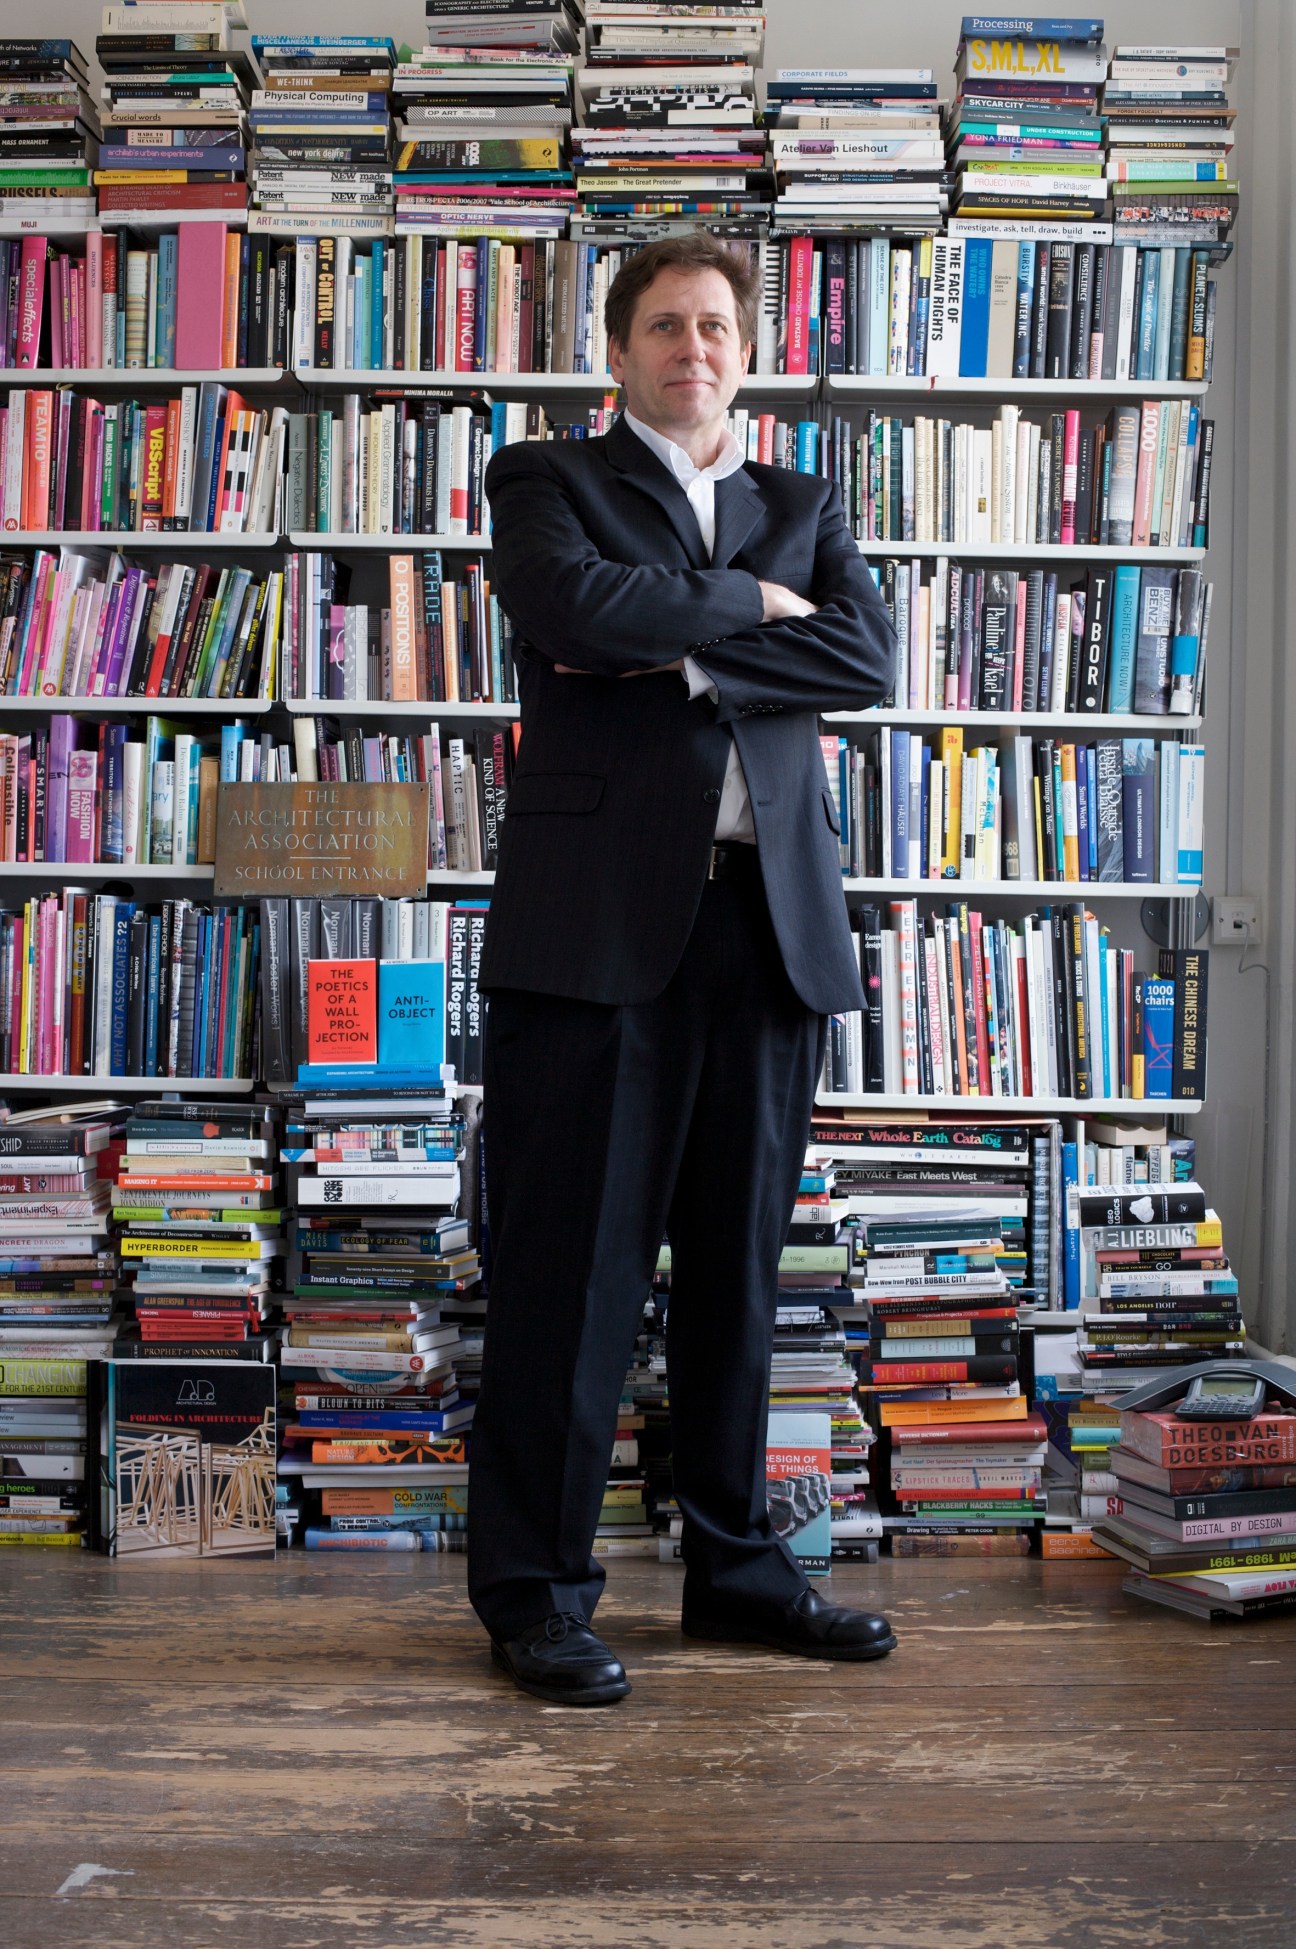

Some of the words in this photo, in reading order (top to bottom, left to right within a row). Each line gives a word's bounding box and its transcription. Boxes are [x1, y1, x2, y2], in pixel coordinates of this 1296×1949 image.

[972, 19, 1033, 32] Processing
[971, 40, 1065, 73] S,M,L,XL
[276, 77, 314, 86] WE-THINK
[264, 91, 306, 101] Physical
[309, 92, 364, 104] Computing
[969, 98, 1002, 109] SKYCAR
[1004, 100, 1024, 109] CITY
[110, 113, 137, 122] Crucial
[139, 113, 162, 121] words
[1048, 128, 1094, 137] CONSTRUCTION
[969, 134, 995, 143] YONA
[997, 135, 1044, 145] FRIEDMAN
[781, 144, 817, 153] Atelier
[819, 144, 839, 153] Van
[842, 144, 888, 153] Lieshout
[653, 178, 682, 186] Pretender
[974, 177, 1010, 187] PROJECT
[1010, 179, 1033, 188] VITRA.
[1053, 181, 1092, 191] Birkhäuser
[20, 221, 38, 229] MUJI
[256, 215, 272, 226] ART
[293, 219, 309, 227] TURN
[310, 219, 318, 227] OF
[319, 219, 330, 227] THE
[331, 218, 383, 228] MILLENNIUM
[955, 223, 1001, 234] investigate,
[1003, 225, 1019, 234] ask,
[1020, 225, 1036, 234] tell,
[1038, 226, 1060, 235] draw,
[1062, 227, 1083, 235] build
[318, 239, 334, 260] OUT
[950, 245, 961, 269] THE
[933, 245, 947, 292] HUMAN
[948, 272, 960, 304] FACE
[22, 258, 37, 343] specialeffects
[317, 273, 334, 324] CONTROL
[461, 290, 475, 322] ART
[826, 278, 845, 345] Empire
[932, 295, 945, 341] RIGHTS
[947, 307, 959, 324] OF
[460, 325, 474, 362] NOW
[34, 395, 48, 460] TEAM10
[105, 423, 114, 442] MIND
[1116, 416, 1135, 479] COLLAPSE
[104, 444, 113, 467] HACKS
[146, 427, 164, 500] VBScript
[985, 607, 1006, 652] Pauline
[1087, 579, 1106, 686] TIBOR
[1120, 593, 1133, 663] ARCHITECTURE
[1158, 637, 1168, 687] UNSTUDIO
[984, 668, 1005, 693] Kael
[451, 745, 463, 794] HAPTIC
[483, 758, 493, 785] KIND
[305, 790, 339, 803] THE
[485, 787, 494, 799] OF
[70, 791, 80, 819] NOW
[79, 791, 92, 840] FASHION
[228, 810, 416, 827] ARCHITECTURAL
[487, 801, 498, 850] SCIENCE
[244, 834, 396, 850] ASSOCIATION
[235, 866, 305, 881] SCHOOL
[311, 867, 407, 880] ENTRANCE
[362, 912, 372, 955] Norman
[451, 917, 466, 979] Richard
[1184, 955, 1199, 977] THE
[330, 969, 354, 979] THE
[316, 982, 369, 992] POETICS
[1147, 985, 1173, 996] 1000
[327, 995, 345, 1004] OF
[348, 995, 357, 1004] A
[394, 995, 429, 1006] ANTI-
[1145, 995, 1175, 1006] chairs
[1183, 979, 1198, 1029] CHINESE
[325, 1007, 359, 1017] WALL
[388, 1008, 435, 1019] OBJECT
[448, 982, 465, 1037] Rogers
[329, 1020, 361, 1030] PRO-
[315, 1032, 369, 1043] JECTION
[1182, 1030, 1197, 1070] DREAM
[815, 1131, 837, 1140] THE
[838, 1131, 864, 1141] NEXT
[868, 1129, 912, 1142] Whole
[912, 1131, 949, 1143] Earth
[953, 1132, 1002, 1148] Catalog
[851, 1170, 892, 1179] MIYAKE
[896, 1171, 917, 1180] East
[919, 1171, 950, 1180] Meets
[952, 1170, 978, 1180] West
[131, 1229, 160, 1237] Architecture
[305, 1231, 327, 1240] MIKE
[1108, 1230, 1118, 1248] A.J.
[1121, 1227, 1192, 1248] LIEBLING
[127, 1243, 199, 1252] HYPERBORDER
[300, 1239, 328, 1248] DAVIS
[341, 1237, 374, 1245] ECOLOGY
[376, 1237, 387, 1245] OF
[389, 1237, 409, 1245] FEAR
[310, 1275, 339, 1284] Instant
[340, 1276, 374, 1286] Graphics
[905, 1277, 923, 1286] POST
[924, 1276, 950, 1285] BUBBLE
[951, 1275, 967, 1284] CITY
[1155, 1301, 1177, 1309] noir
[20, 1385, 35, 1393] THE
[36, 1384, 54, 1393] 21ST
[55, 1384, 87, 1393] CENTURY
[130, 1414, 169, 1422] FOLDING
[188, 1415, 263, 1423] ARCHITECTURE
[1169, 1427, 1222, 1444] THEO
[1238, 1422, 1279, 1440] VAN
[803, 1455, 817, 1464] OF
[1169, 1444, 1280, 1465] DOESBURG
[780, 1464, 819, 1474] THINGS
[6, 1484, 36, 1493] heroes
[394, 1493, 422, 1502] COLD
[424, 1492, 448, 1501] WAR
[922, 1501, 968, 1510] BLACKBERRY
[969, 1501, 994, 1510] HACKS
[1185, 1522, 1225, 1537] DIGITAL
[1231, 1521, 1242, 1532] BY
[1248, 1518, 1282, 1530] DESIGN
